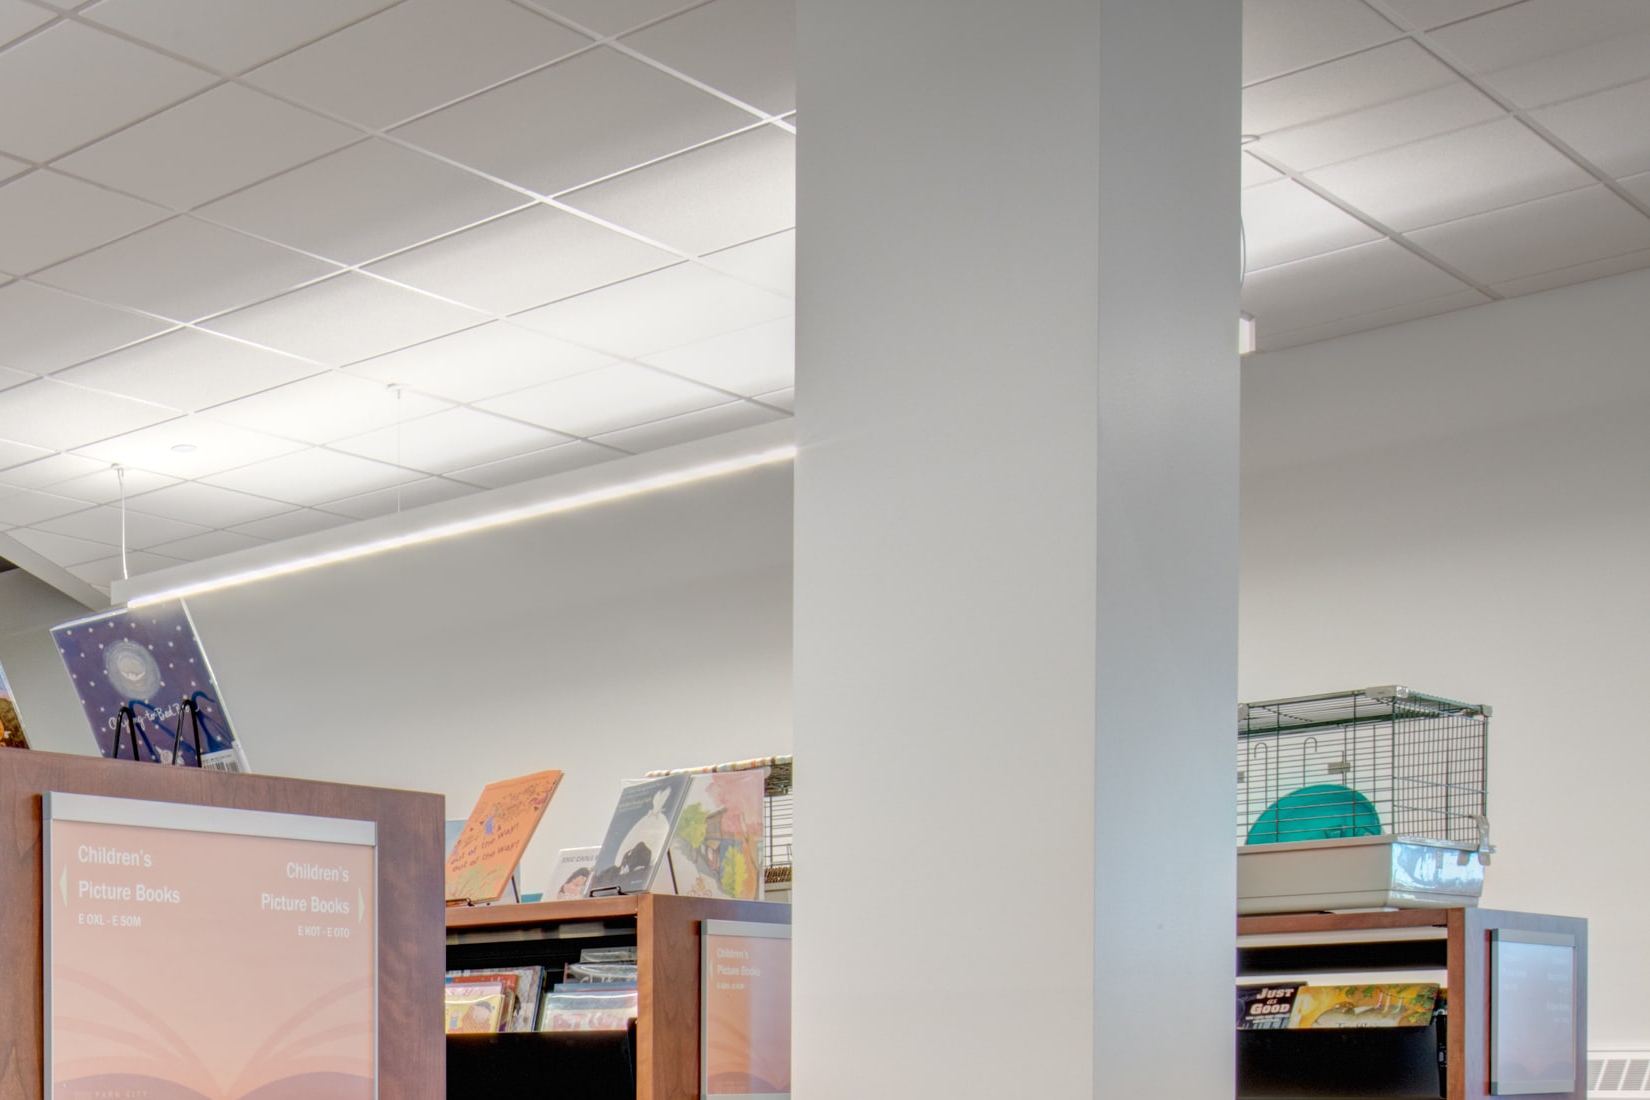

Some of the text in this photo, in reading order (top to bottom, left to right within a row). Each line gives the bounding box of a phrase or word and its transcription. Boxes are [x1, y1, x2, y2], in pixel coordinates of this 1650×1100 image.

[78, 845, 152, 868] Children's
[286, 862, 349, 883] Children's
[78, 880, 180, 904] Picture Books
[261, 893, 350, 915] Picture Books
[78, 913, 85, 926] E
[112, 915, 119, 927] E
[298, 925, 303, 936] E
[327, 926, 332, 937] E
[717, 965, 739, 976] Picture
[1256, 988, 1295, 999] JUST
[1250, 1003, 1290, 1015] GOOD
